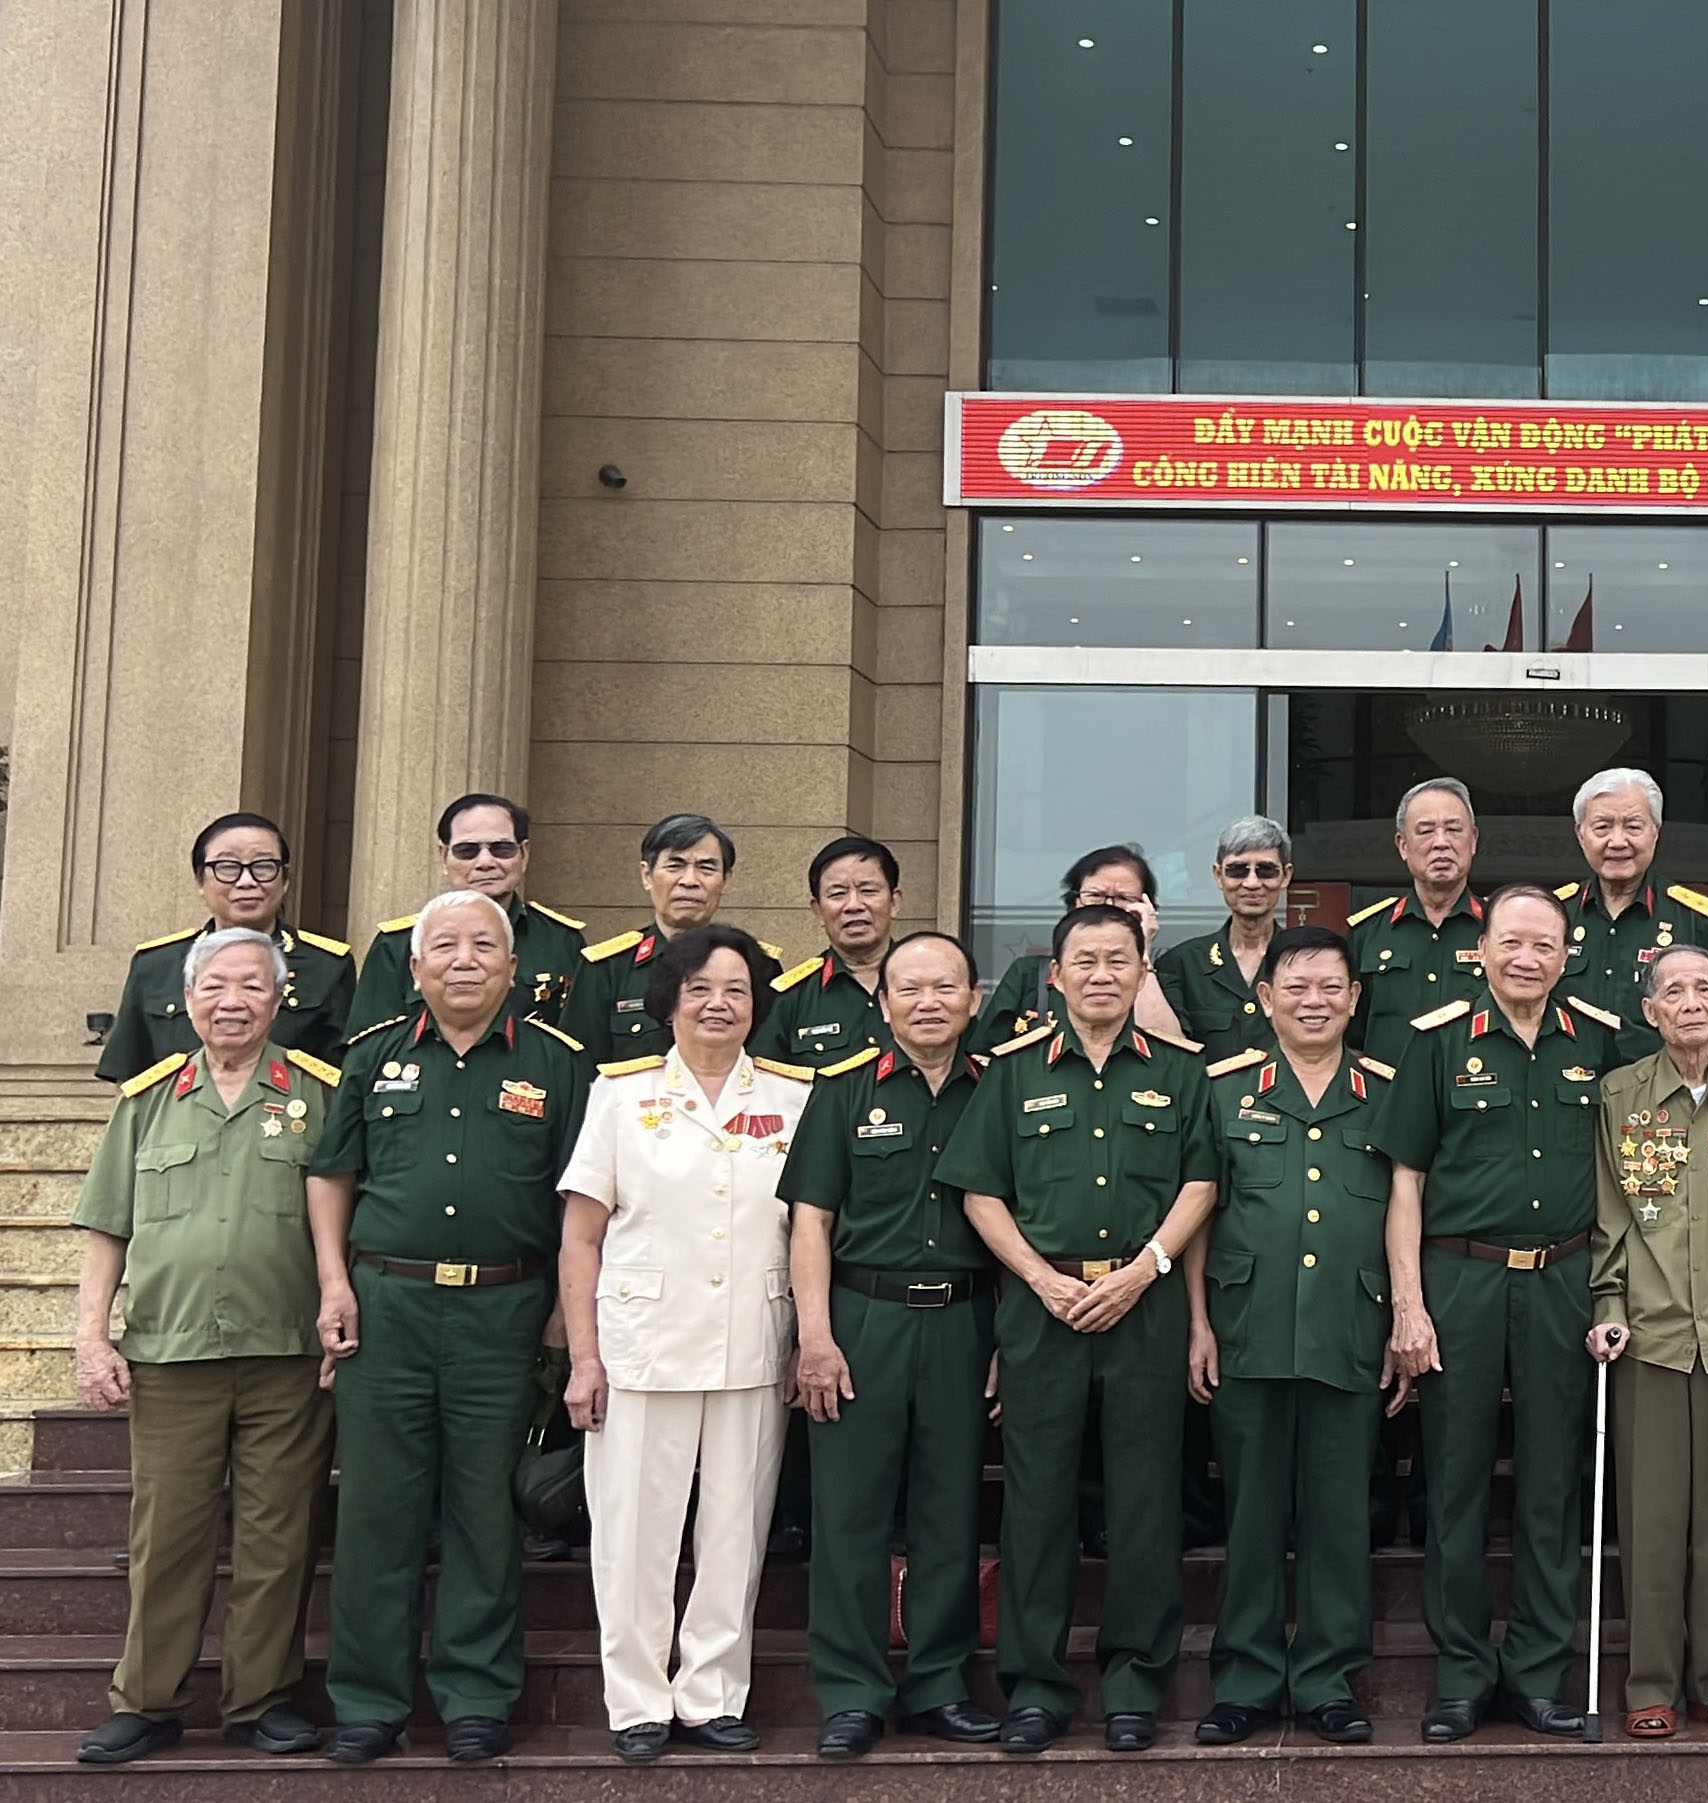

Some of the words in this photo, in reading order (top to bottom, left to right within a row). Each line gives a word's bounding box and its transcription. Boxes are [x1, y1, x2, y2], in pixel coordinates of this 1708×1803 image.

[1262, 418, 1355, 451] MẠNH
[1363, 414, 1444, 452] CUỘC
[1451, 416, 1513, 453] VẬN
[1519, 417, 1607, 455] ĐỘNG
[1309, 457, 1361, 489] TÀI
[1368, 458, 1463, 497] NĂNG,
[1469, 460, 1559, 493] XỨNG
[1565, 466, 1651, 494] DANH
[1657, 462, 1701, 499] BỘ
